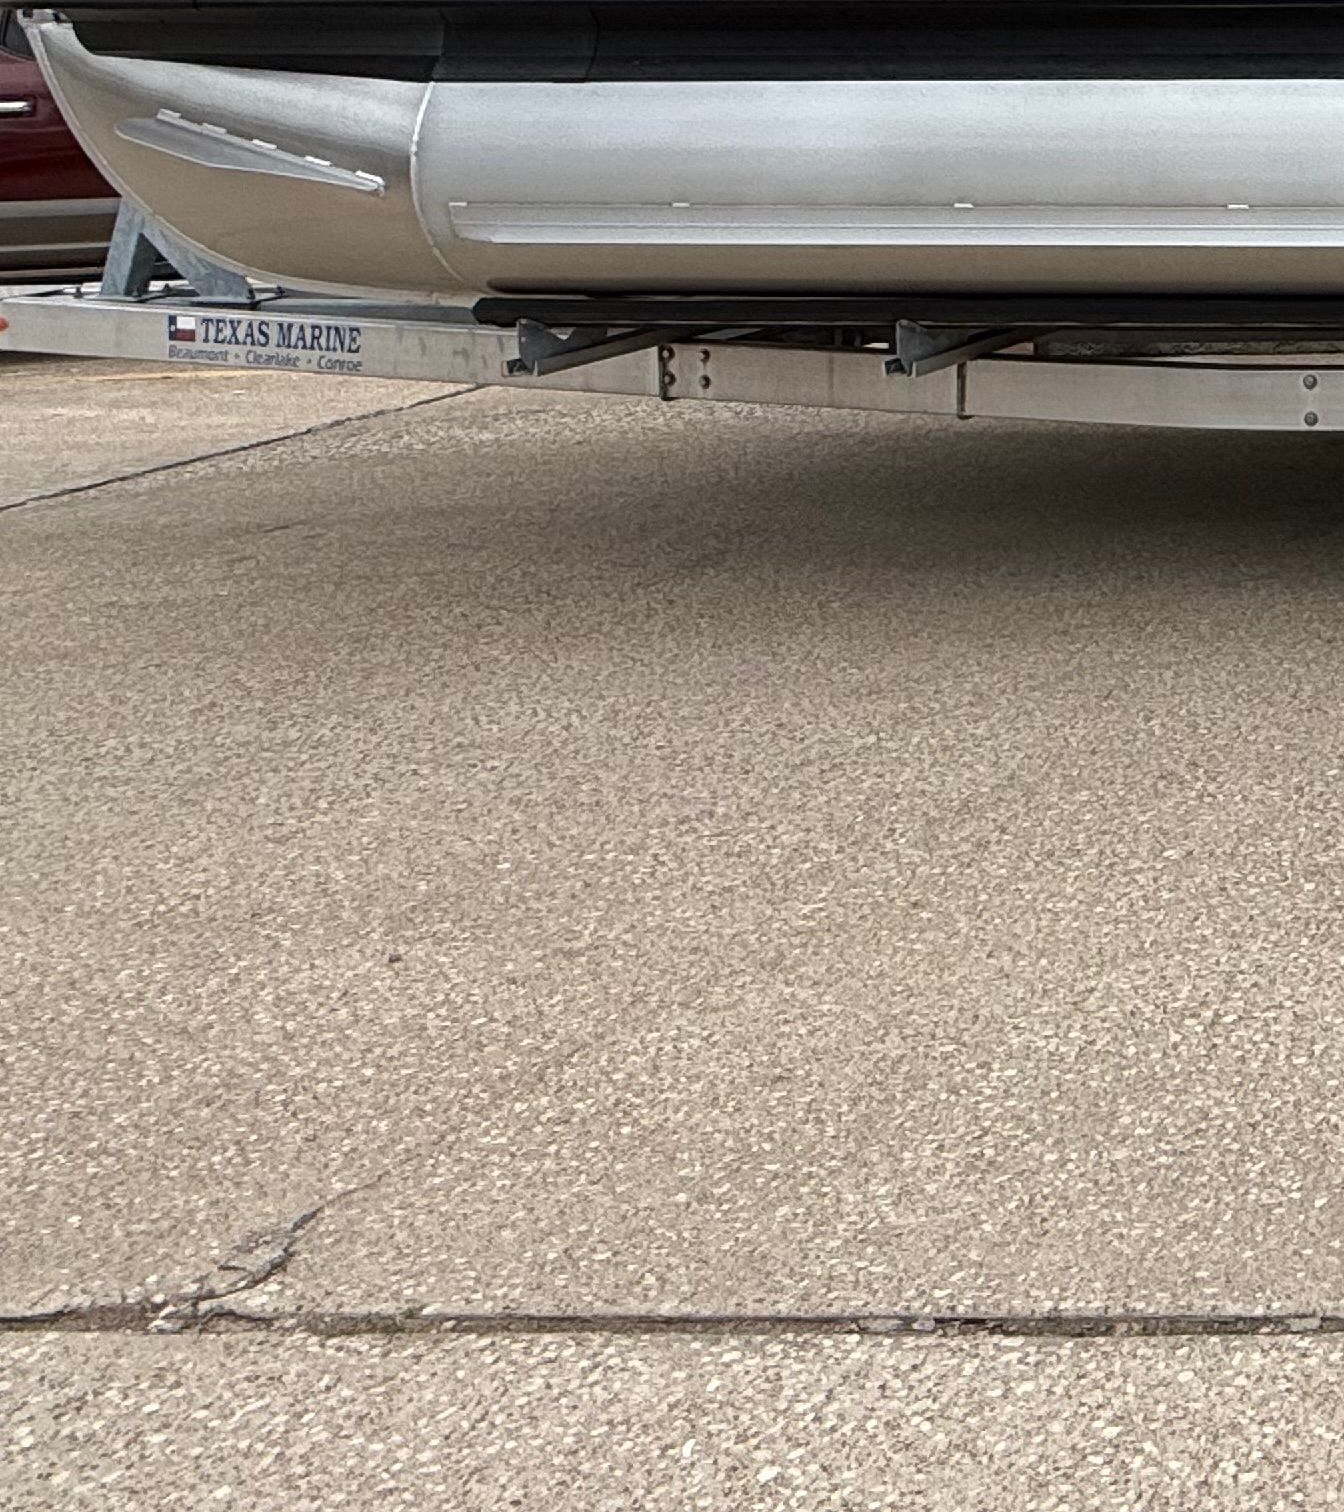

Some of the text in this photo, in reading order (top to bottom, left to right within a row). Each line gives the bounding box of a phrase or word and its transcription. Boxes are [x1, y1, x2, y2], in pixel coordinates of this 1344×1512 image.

[201, 318, 362, 354] TEXAS MARINE
[168, 344, 229, 362] Beaumont
[316, 355, 363, 372] Conroe
